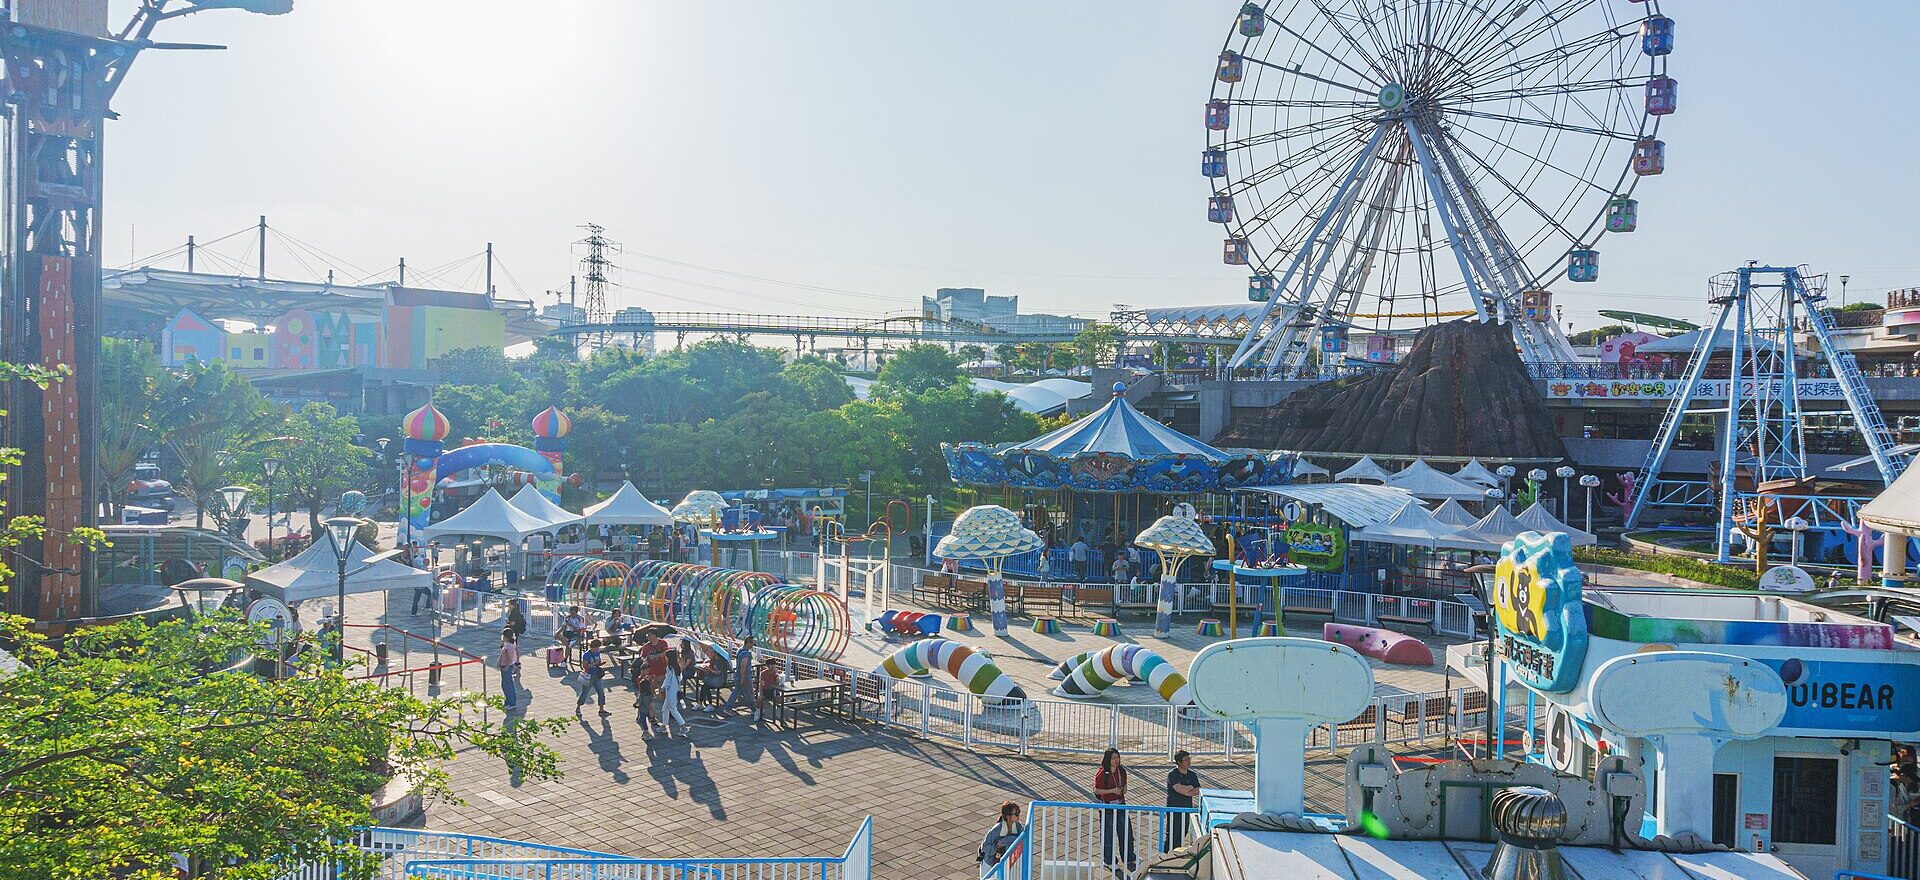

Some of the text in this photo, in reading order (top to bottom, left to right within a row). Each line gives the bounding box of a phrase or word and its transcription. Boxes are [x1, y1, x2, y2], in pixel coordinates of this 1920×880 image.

[1287, 503, 1295, 520] 1
[1499, 582, 1506, 604] 4
[1785, 682, 1894, 710] O!BEAR
[1551, 711, 1566, 765] 4
